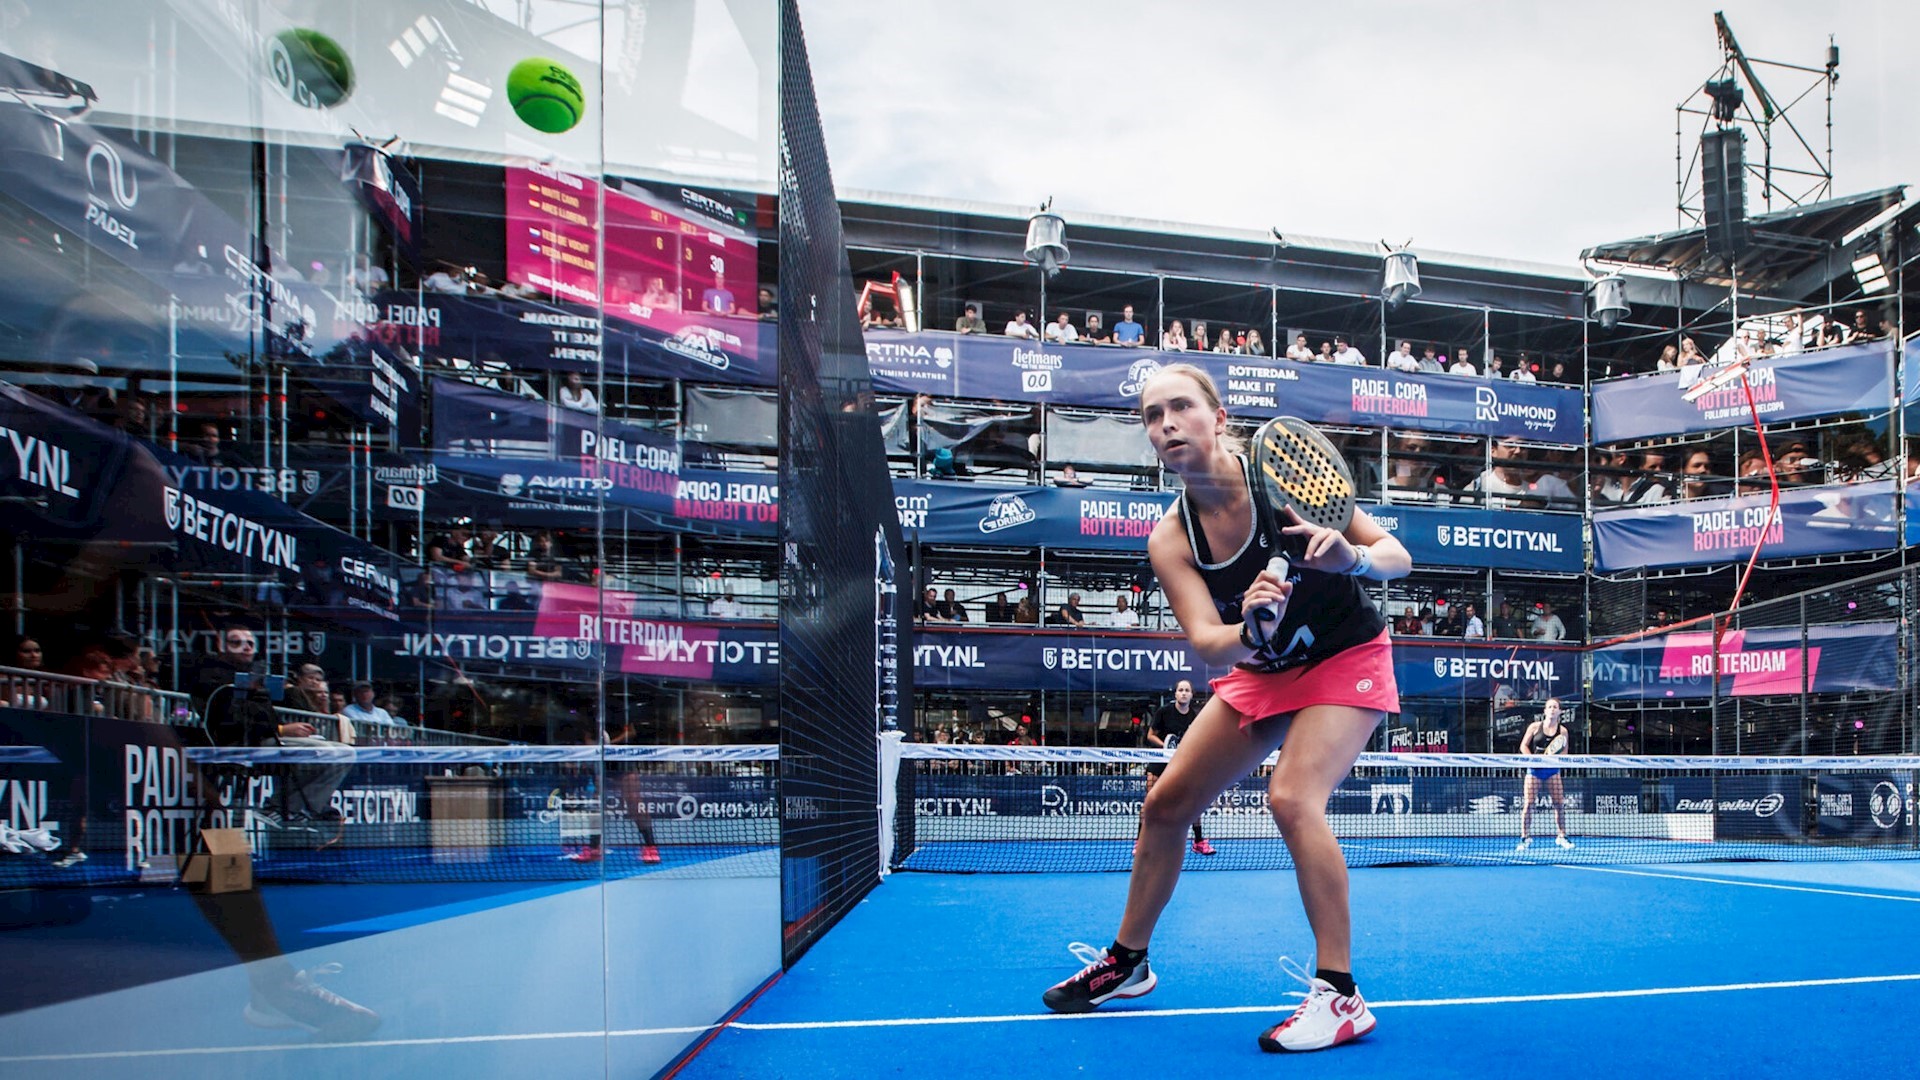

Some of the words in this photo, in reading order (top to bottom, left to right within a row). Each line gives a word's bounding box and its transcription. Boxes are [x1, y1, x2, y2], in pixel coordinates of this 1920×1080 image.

[681, 188, 735, 217] CERTINA
[85, 203, 139, 250] PADEL
[656, 237, 663, 250] 6
[685, 248, 693, 261] 3
[710, 255, 725, 274] 30
[1011, 347, 1063, 369] Liefmans
[880, 369, 909, 378] TIMING
[911, 371, 947, 380] PARTNER
[1228, 365, 1299, 380] ROTTERDAM.
[1228, 381, 1261, 392] MAKE
[1265, 382, 1276, 392] IT
[1352, 378, 1392, 398] PADEL
[1396, 382, 1427, 401] COPA
[1697, 384, 1777, 411] ROTTERAM
[1228, 394, 1278, 408] HAPPEN.
[1352, 396, 1428, 417] ROTTERDAM
[1704, 406, 1730, 421] FOLLOW
[1731, 407, 1740, 416] US
[1740, 401, 1785, 416] @PDELCOPA
[636, 444, 679, 476] COPA
[996, 513, 1026, 527] DRINK
[999, 502, 1019, 518] AA
[1080, 500, 1125, 519] PADEL
[1128, 502, 1164, 521] COPA
[1693, 510, 1739, 533] PADEL
[183, 493, 300, 574] BETCITY.NL
[1453, 526, 1563, 552] BETCITY.NL
[580, 613, 683, 646] ROTERDAM
[1061, 648, 1192, 671] BETCITY.NL
[1449, 658, 1560, 681] BETCITY.NL
[1691, 651, 1786, 676] ROTERDAM
[125, 745, 207, 807] PADEL
[638, 803, 675, 814] RENT
[1374, 790, 1411, 814] AD
[1595, 794, 1619, 805] PADEL
[1619, 794, 1639, 805] COPA
[1089, 969, 1124, 992] BPL
